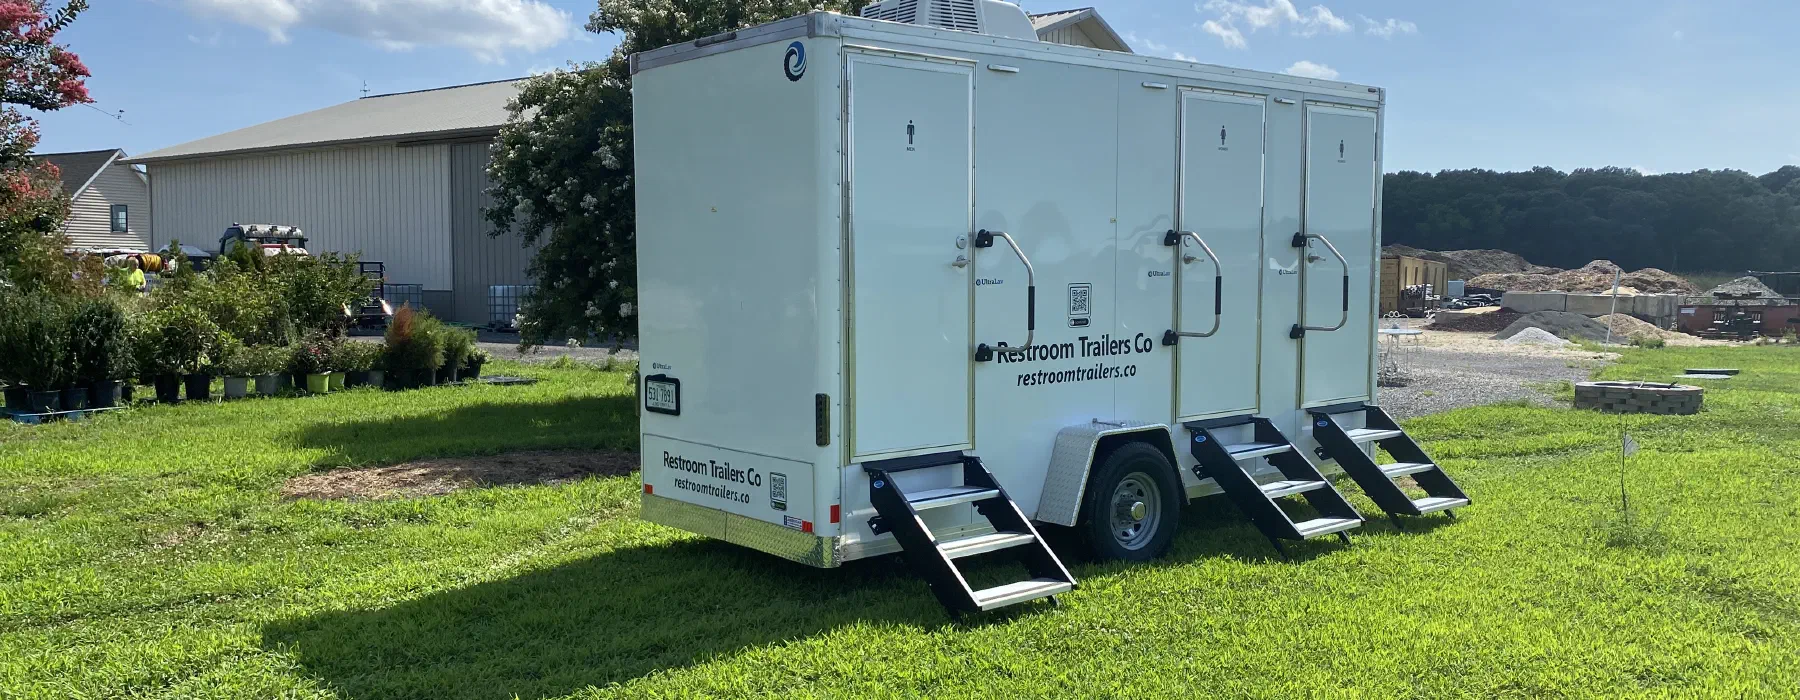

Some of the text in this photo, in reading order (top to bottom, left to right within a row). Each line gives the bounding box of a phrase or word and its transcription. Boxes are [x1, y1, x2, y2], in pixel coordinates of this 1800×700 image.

[997, 332, 1153, 364] Restroom Trailers Co
[1016, 362, 1137, 387] restroomtrailers.co
[663, 450, 762, 487] Restroom Trailers Co
[674, 477, 750, 504] restroomtrailers.co
